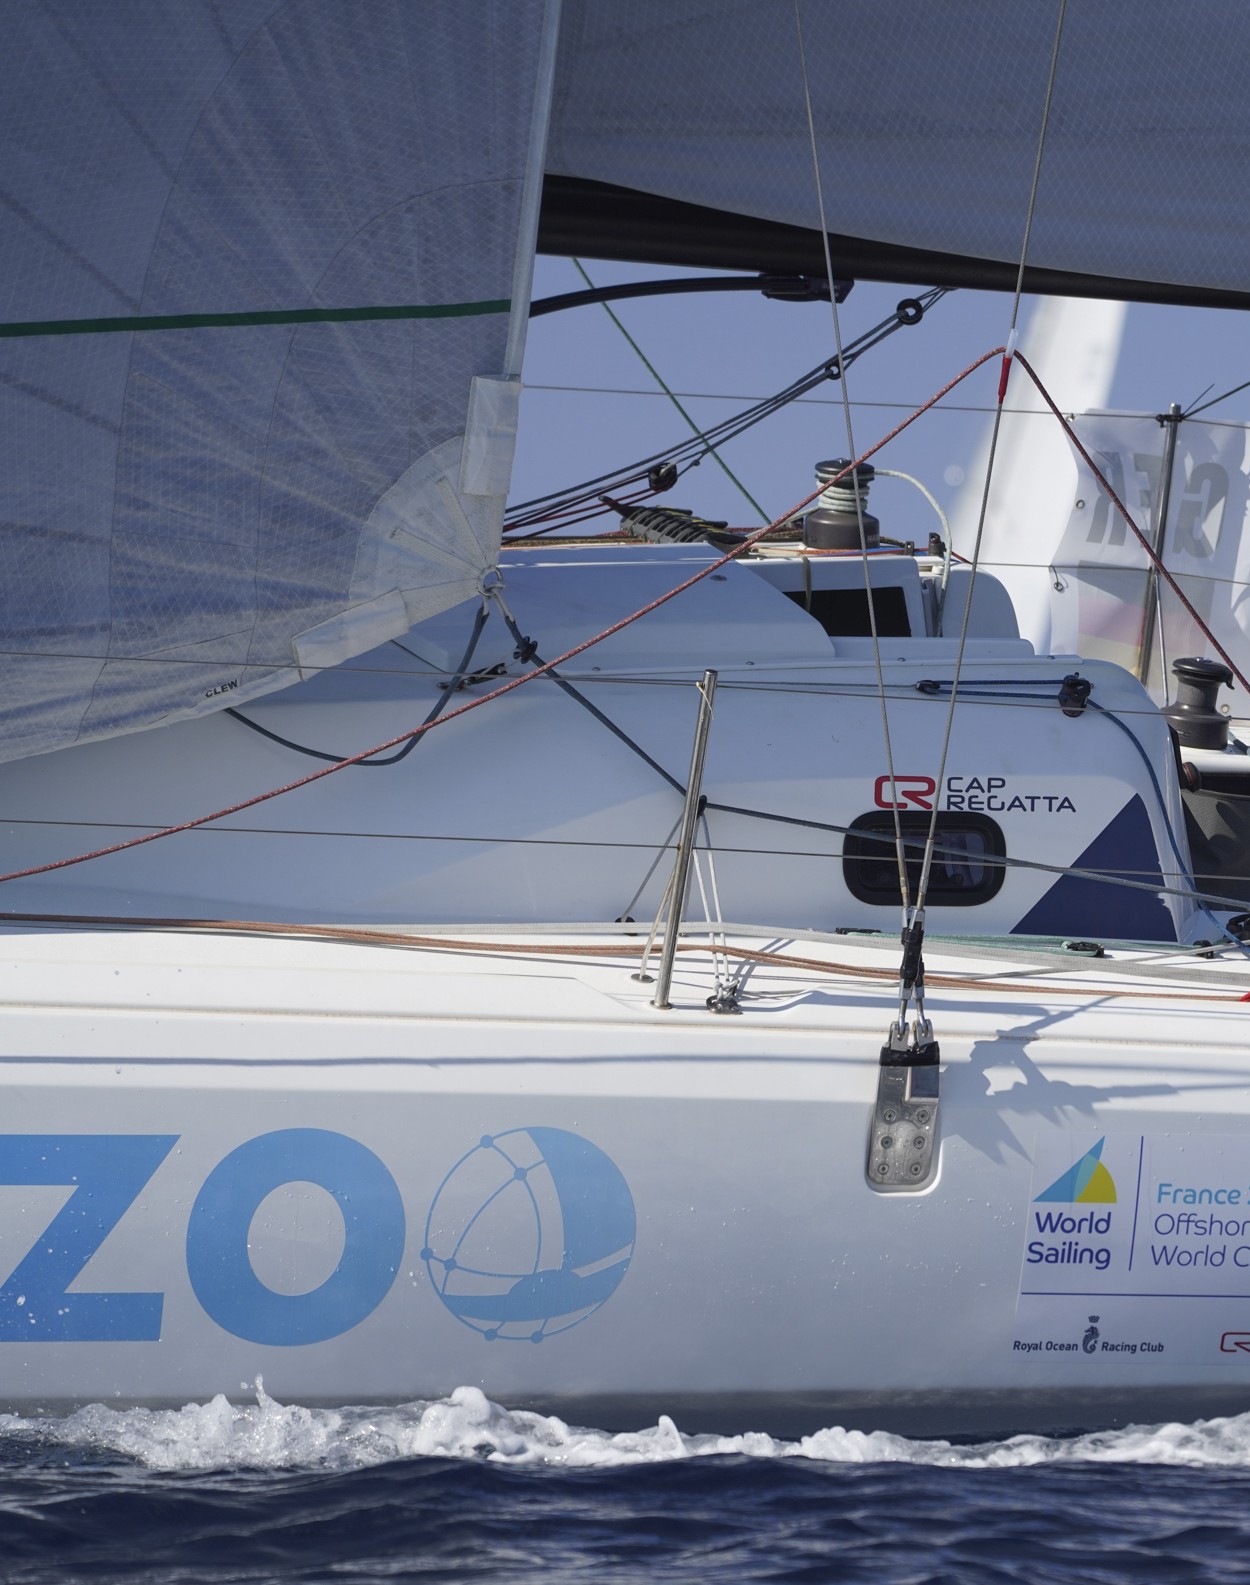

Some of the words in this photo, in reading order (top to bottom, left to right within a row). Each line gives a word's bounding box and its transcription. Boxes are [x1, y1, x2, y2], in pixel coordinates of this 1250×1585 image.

[205, 679, 238, 698] CLEW
[946, 777, 1006, 794] CAP
[946, 794, 1076, 813] REGATTA
[1157, 1183, 1241, 1205] France
[1035, 1211, 1111, 1235] World
[0, 1128, 406, 1347] ZO
[1026, 1241, 1111, 1270] Sailing
[1151, 1244, 1227, 1267] World
[1013, 1340, 1043, 1353] Royal
[1045, 1341, 1079, 1352] Ocean
[1101, 1341, 1138, 1355] Racing
[1140, 1342, 1165, 1353] Club
